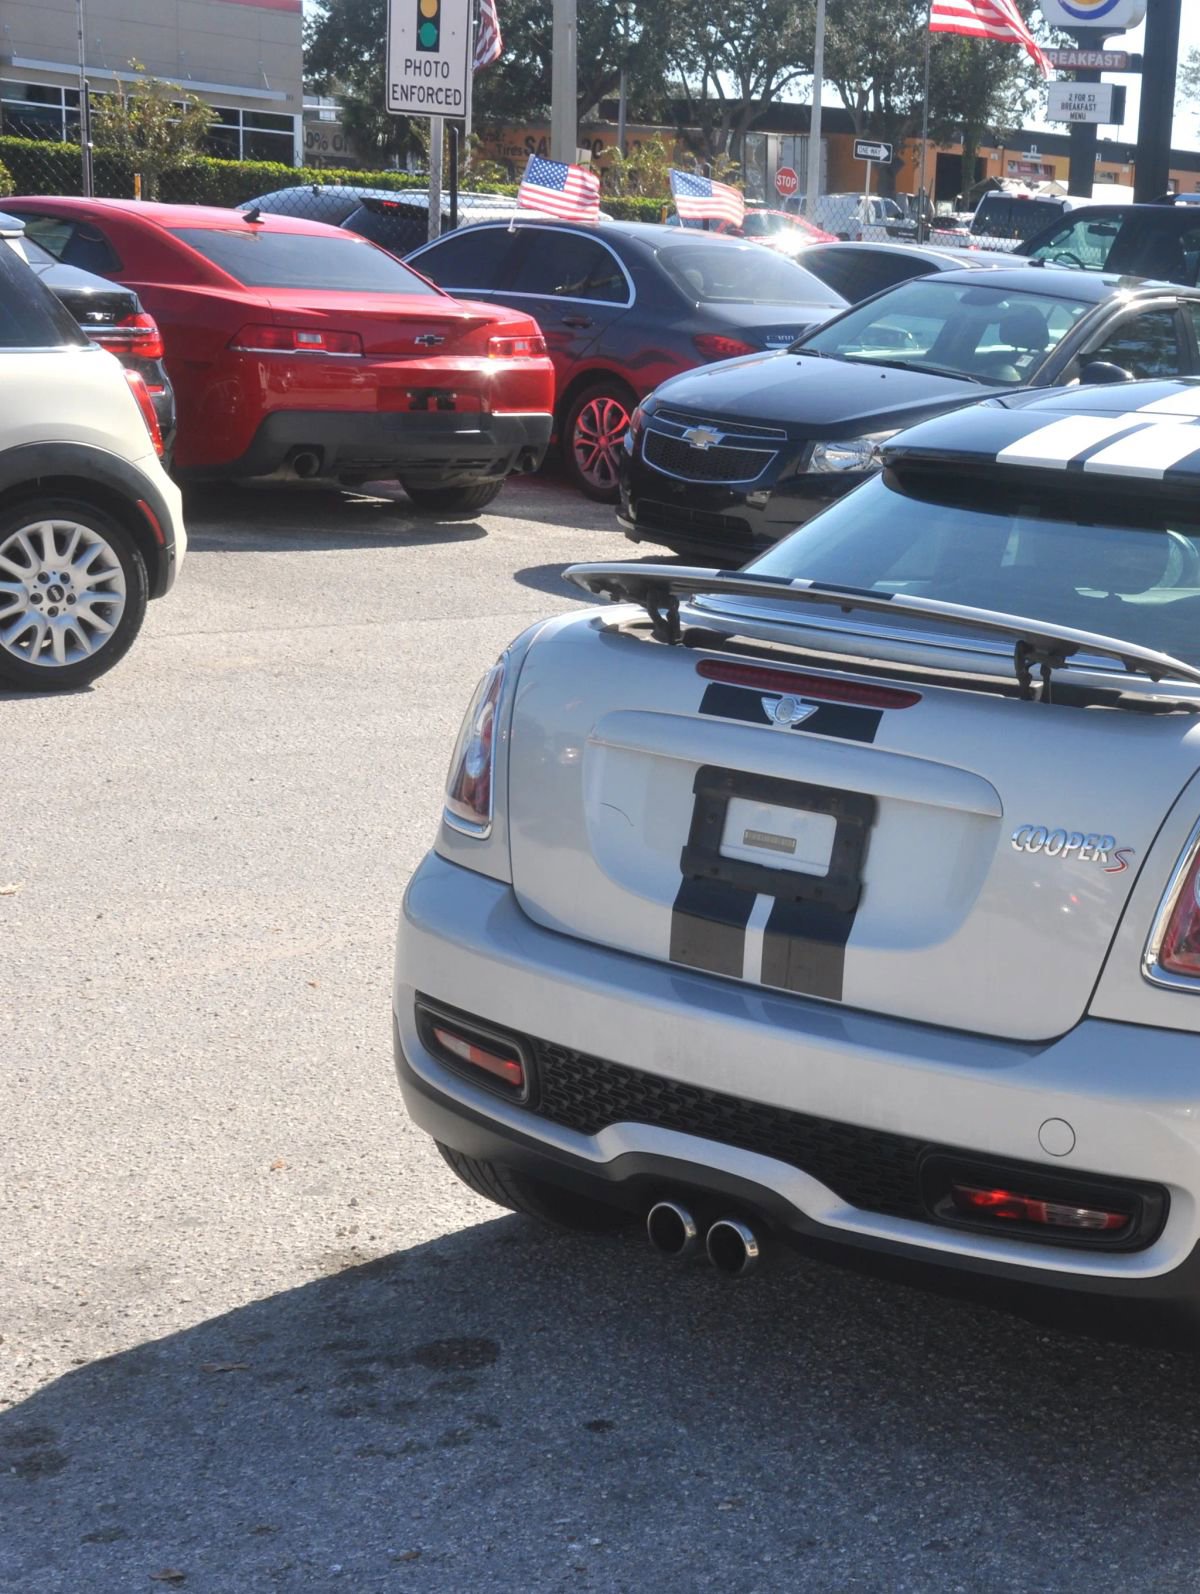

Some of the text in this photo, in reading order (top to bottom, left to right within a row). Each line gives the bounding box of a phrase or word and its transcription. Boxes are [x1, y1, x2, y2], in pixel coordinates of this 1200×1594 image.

[404, 58, 450, 79] PHOTO
[391, 83, 462, 106] ENFORCED
[1074, 93, 1086, 102] FOR
[1060, 101, 1097, 112] BREAKFAST
[1069, 111, 1087, 121] MENU
[858, 145, 881, 156] ONE WAY
[776, 175, 797, 189] STOP
[1011, 823, 1136, 874] COOPER S
